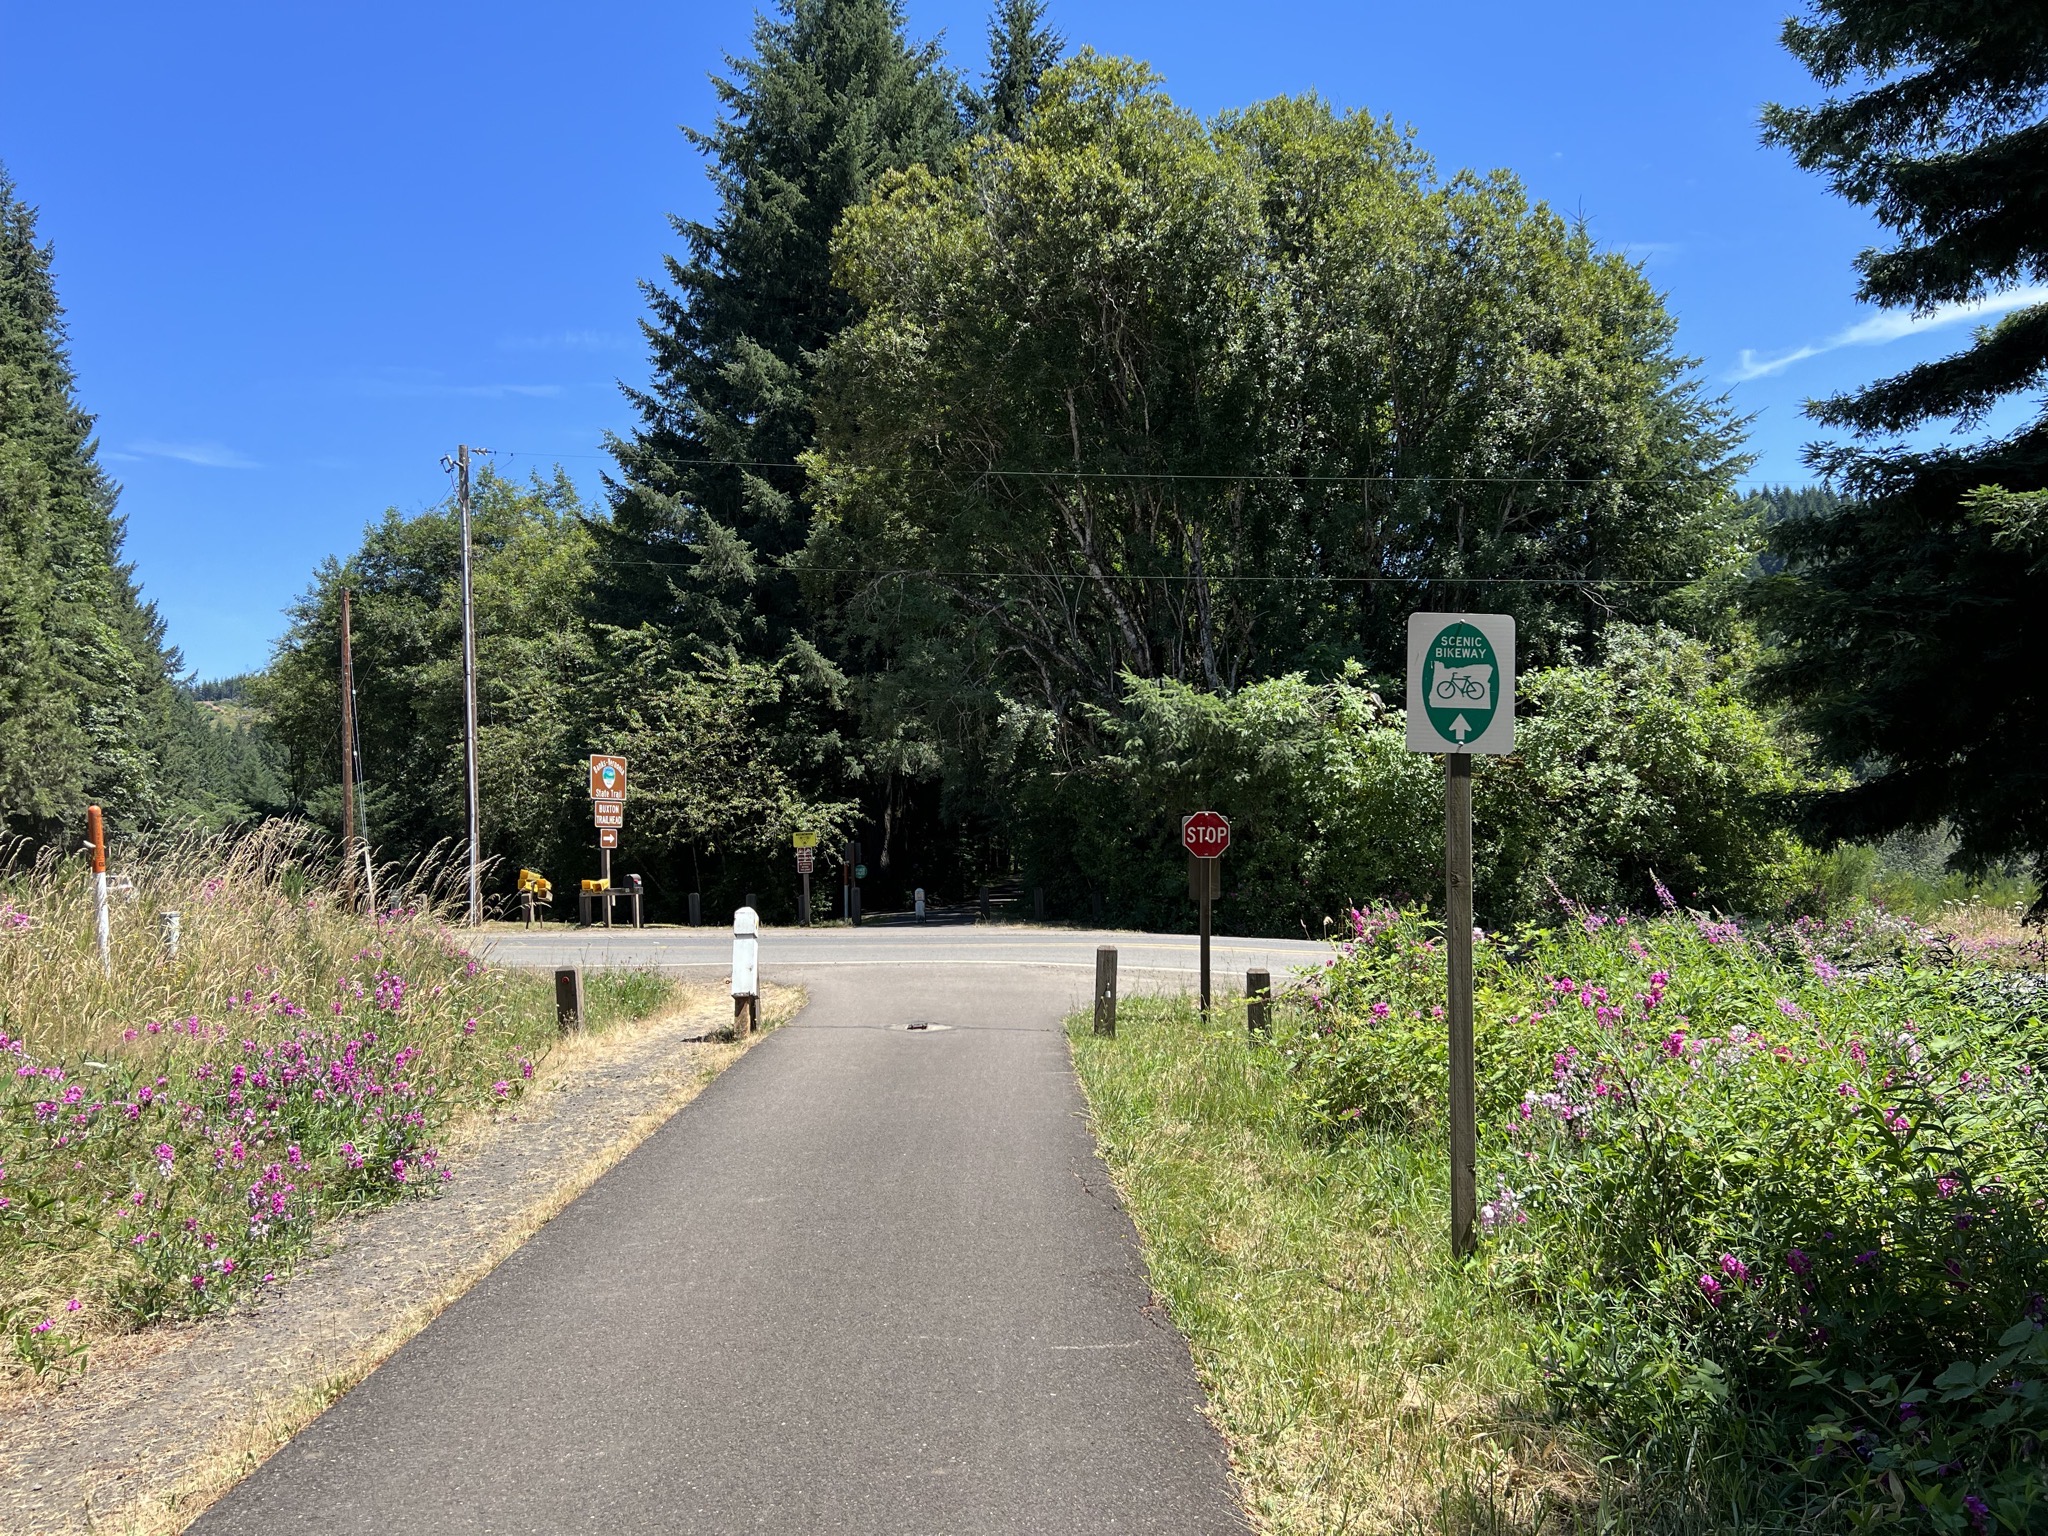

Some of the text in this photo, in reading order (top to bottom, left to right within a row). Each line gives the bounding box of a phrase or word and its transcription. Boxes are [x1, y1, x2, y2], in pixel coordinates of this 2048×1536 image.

[1441, 636, 1482, 647] SCENIC
[1436, 648, 1486, 658] BIKEWAY
[596, 789, 622, 799] State Trail
[599, 805, 619, 813] BUXTON
[596, 815, 622, 824] TRAILHEAD
[1187, 827, 1227, 843] STOP
